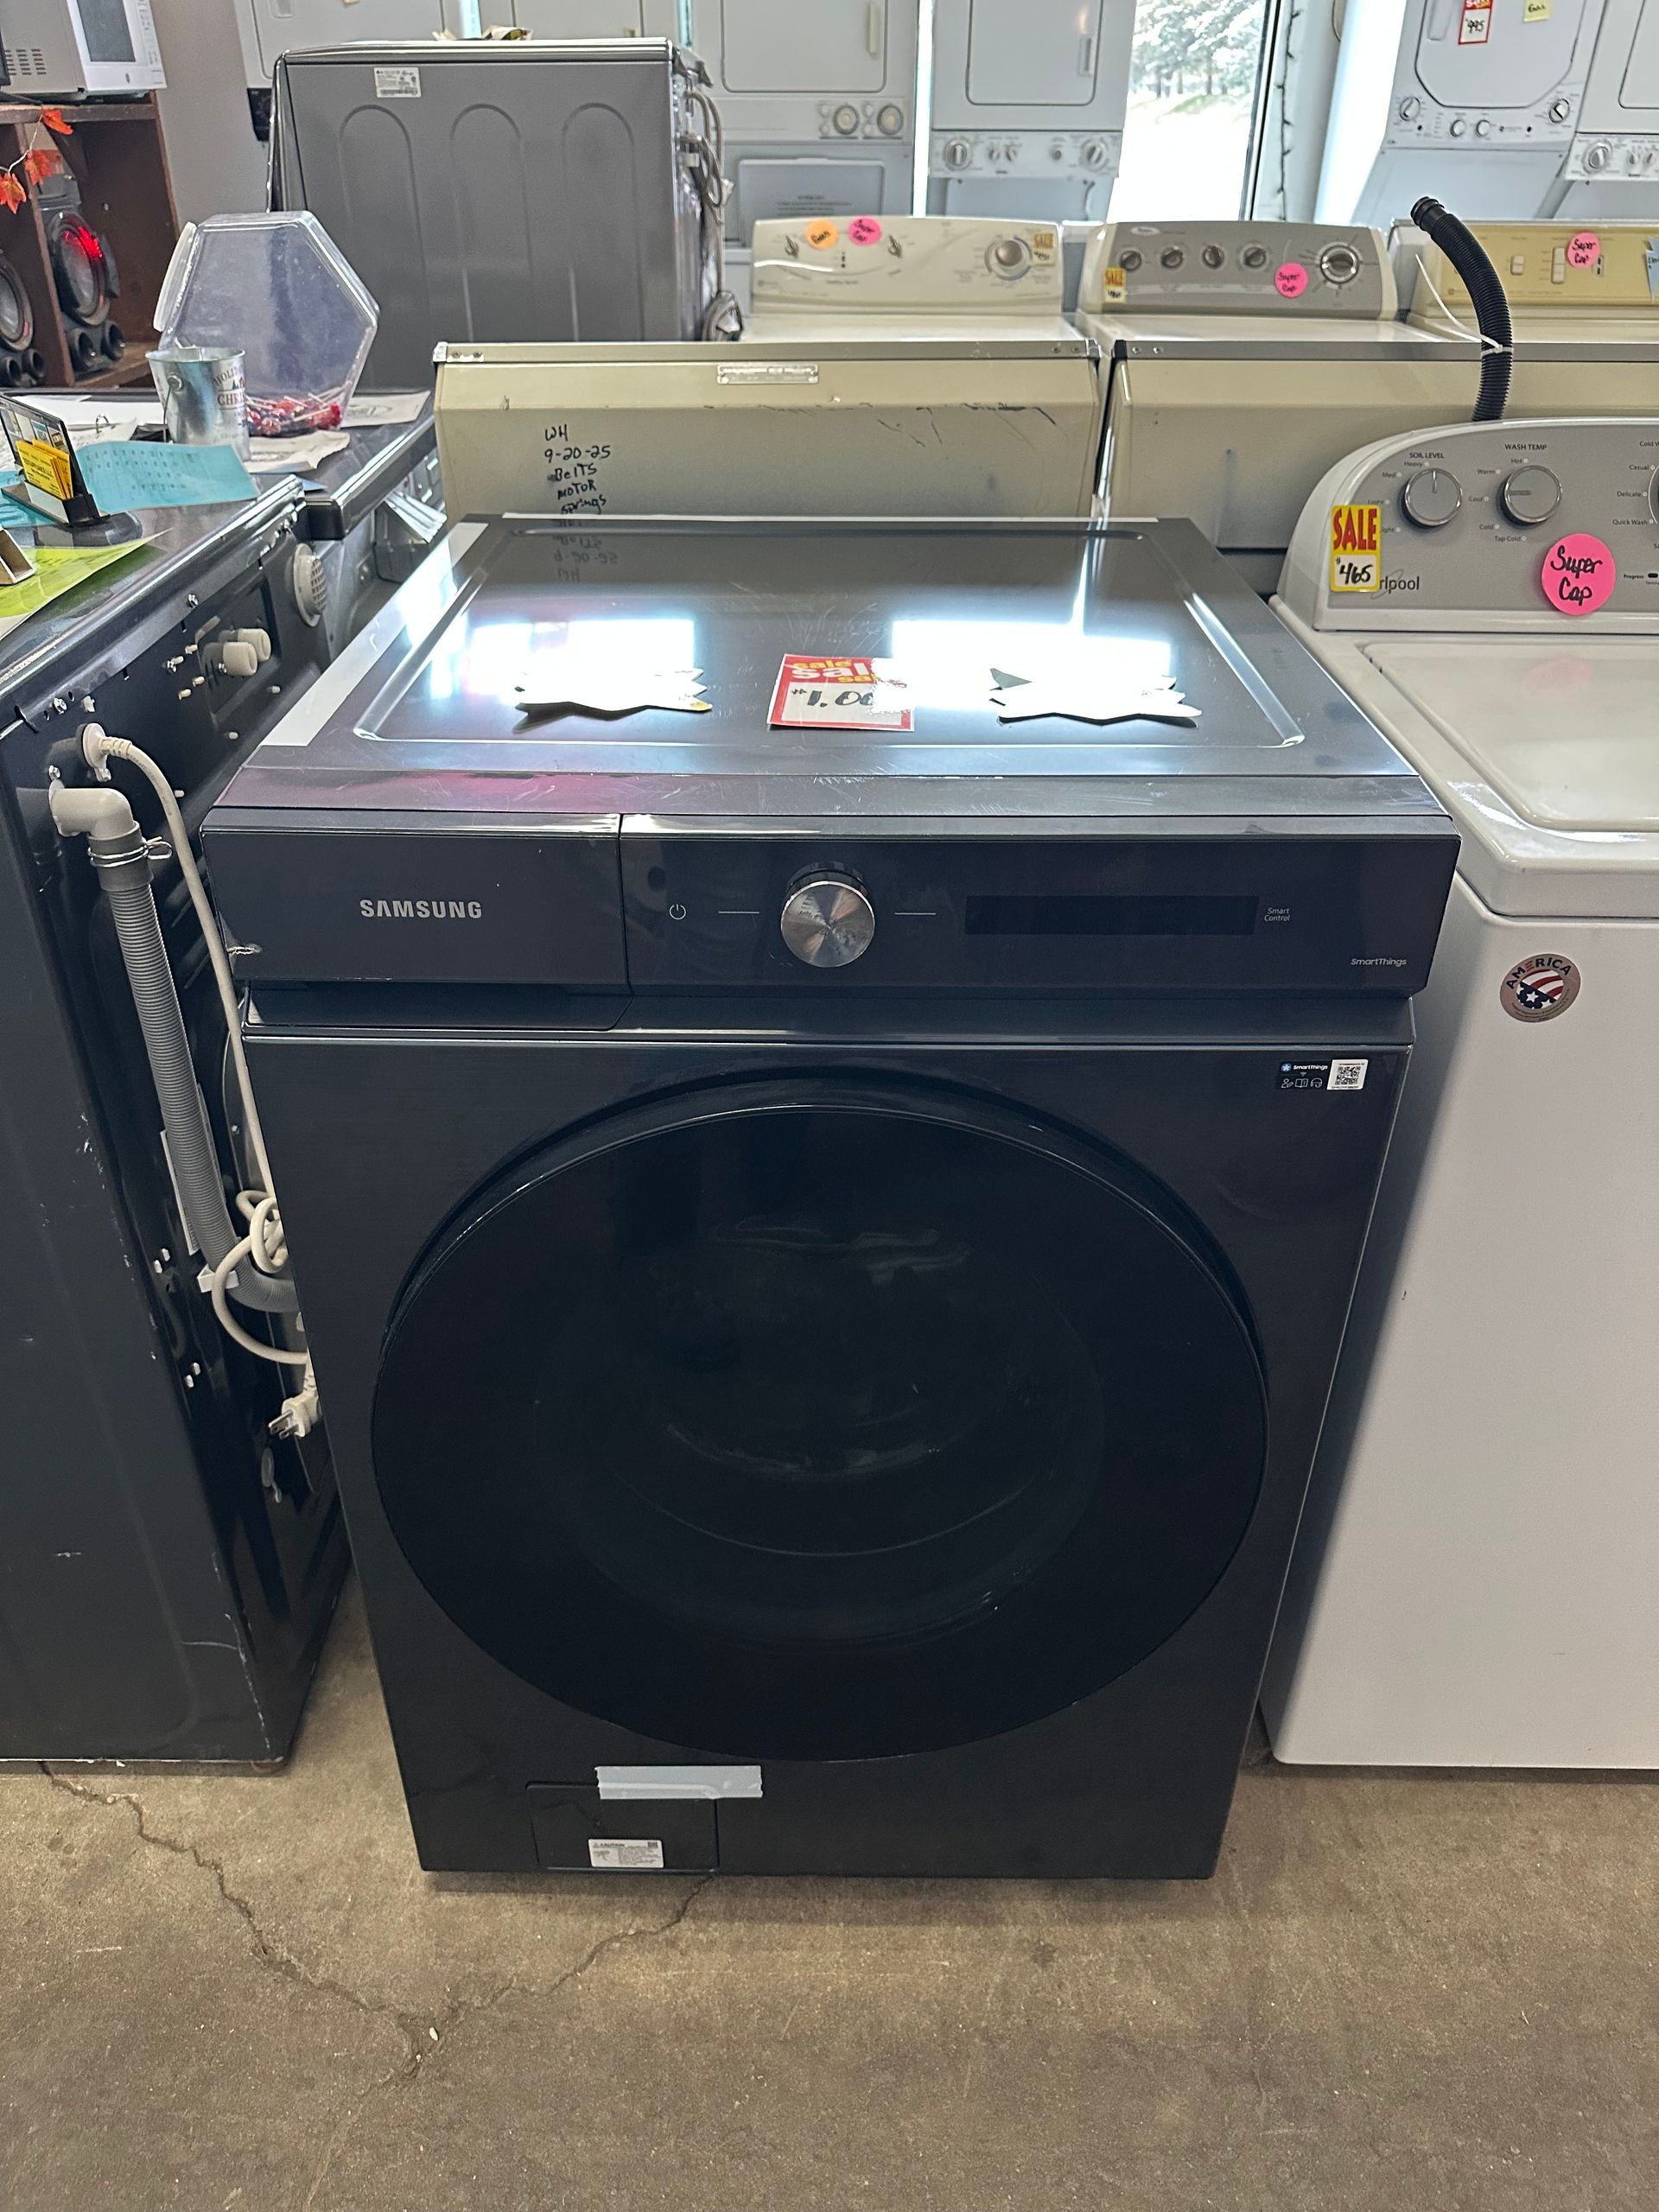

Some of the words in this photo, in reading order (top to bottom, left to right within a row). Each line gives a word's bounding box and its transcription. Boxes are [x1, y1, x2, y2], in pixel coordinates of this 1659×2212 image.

[544, 445, 612, 464] 9-20-25
[1333, 507, 1377, 551] SALE
[1550, 545, 1603, 579] Super
[1559, 576, 1592, 607] Cap
[359, 899, 482, 919] SAMSUNG
[1351, 957, 1407, 968] SmartThings
[1506, 957, 1572, 989] AMERICA
